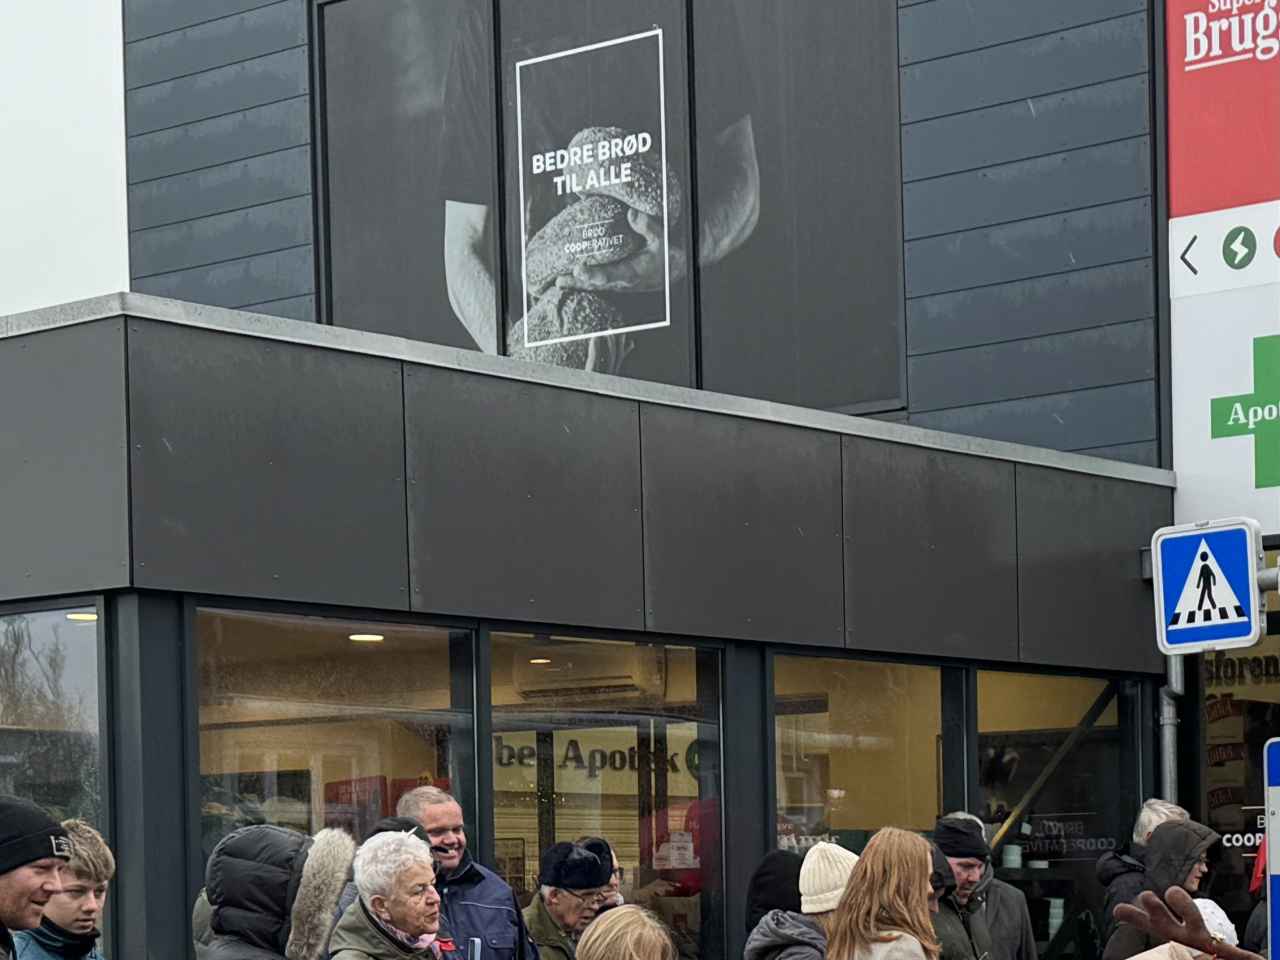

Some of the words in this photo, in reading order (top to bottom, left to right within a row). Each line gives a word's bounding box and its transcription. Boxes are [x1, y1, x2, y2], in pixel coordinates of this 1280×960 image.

[532, 143, 594, 174] BEDRE
[598, 132, 652, 161] BRØD
[553, 173, 582, 195] TIL
[586, 162, 632, 190] ALLE
[564, 234, 624, 253] COOPERATIVET
